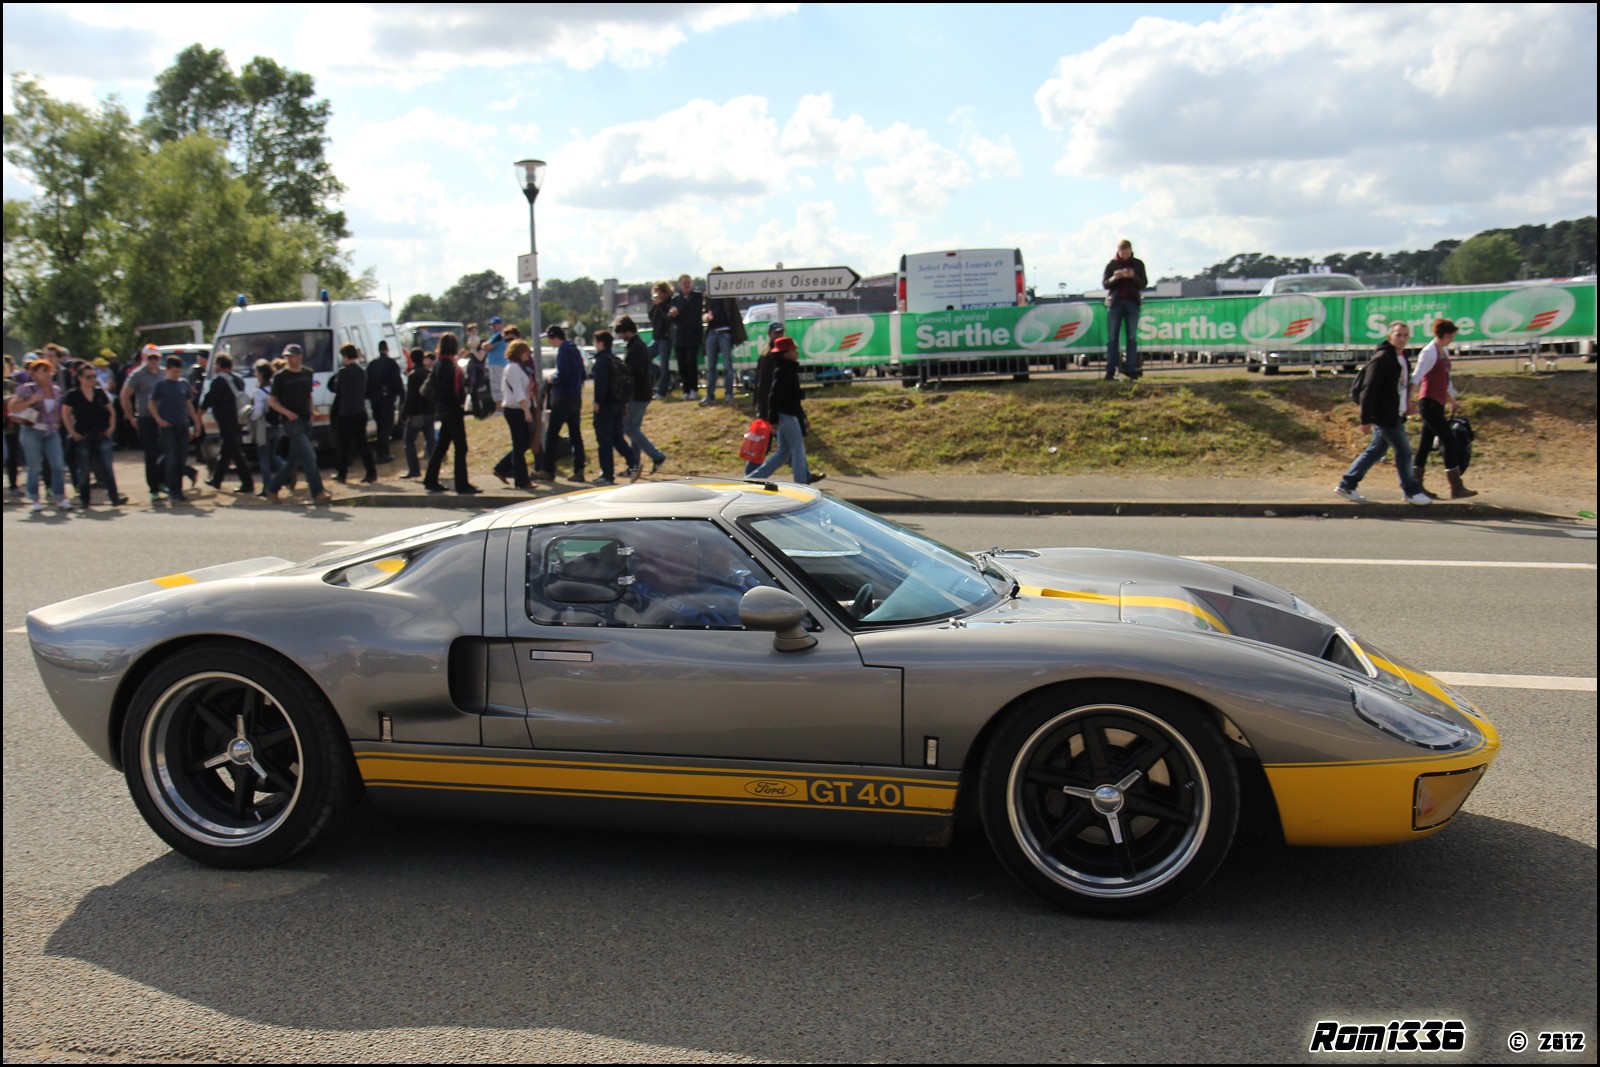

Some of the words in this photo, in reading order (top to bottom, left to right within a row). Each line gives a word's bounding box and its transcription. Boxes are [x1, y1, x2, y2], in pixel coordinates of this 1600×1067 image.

[918, 263, 941, 273] Select
[943, 261, 962, 270] Poids
[965, 260, 991, 269] Lourds
[714, 279, 754, 291] Jardin
[761, 276, 784, 288] des
[791, 275, 843, 287] Oiseaux
[1178, 304, 1215, 317] général
[1411, 299, 1451, 313] général
[916, 312, 950, 323] Conseil
[954, 311, 989, 324] général
[1366, 312, 1475, 339] Srte
[916, 322, 1010, 348] Sarthe
[1137, 315, 1236, 340] Sarthe
[754, 781, 787, 795] Ford
[810, 780, 853, 803] GT
[857, 783, 900, 807] 40
